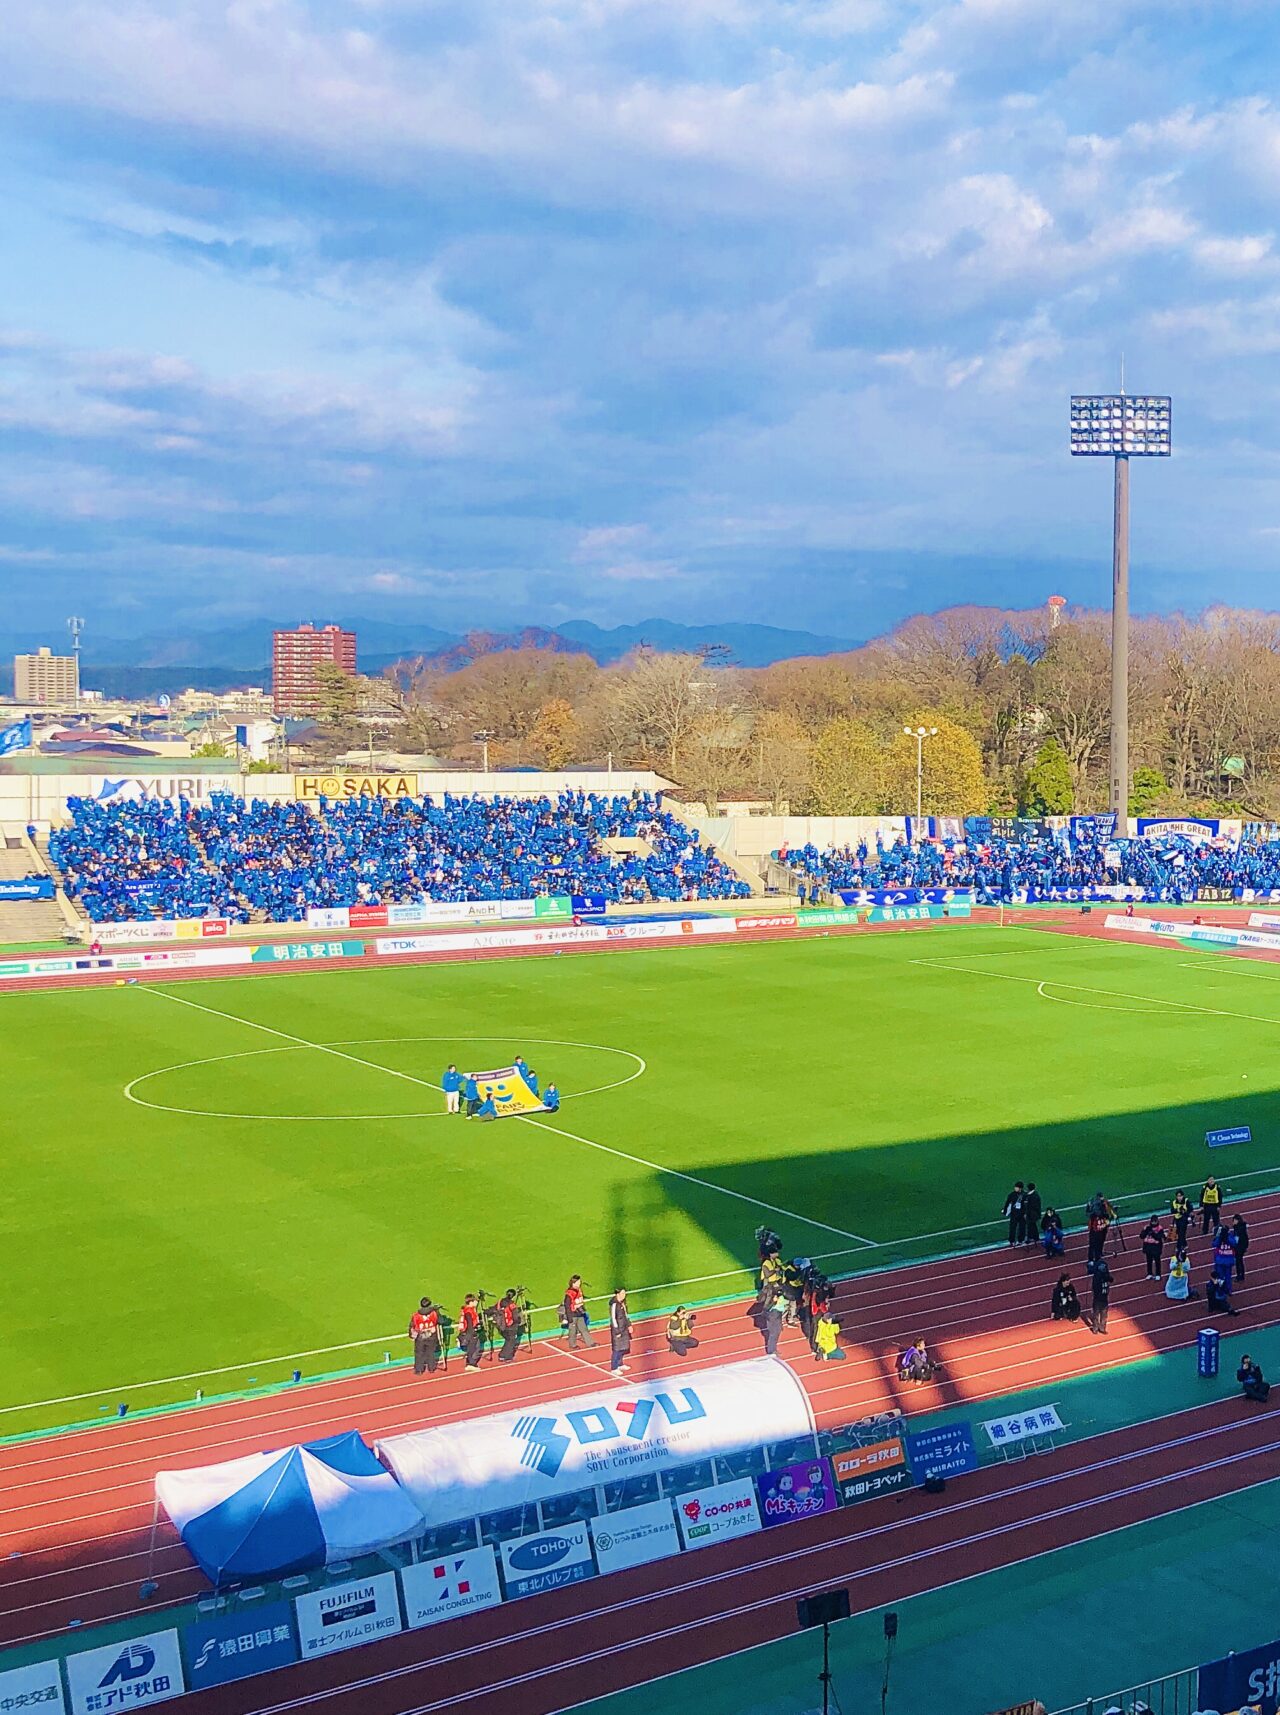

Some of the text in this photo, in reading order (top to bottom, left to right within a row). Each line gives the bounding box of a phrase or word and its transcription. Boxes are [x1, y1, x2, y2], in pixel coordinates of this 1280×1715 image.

[135, 779, 202, 798] YURI
[1187, 823, 1211, 836] GREAT
[882, 907, 930, 920] 明治安田
[96, 927, 150, 939] スポーツくじ
[606, 927, 625, 936] ADK
[629, 925, 666, 936] グループ
[273, 942, 344, 960] 明治安田
[390, 940, 417, 949] TDK
[511, 1387, 707, 1479] SOYU
[990, 1411, 1056, 1439] 細谷病院
[584, 1431, 691, 1462] The Amusement creator
[587, 1447, 669, 1473] SOYU Corporation
[838, 1447, 900, 1472] カローラ秋田
[932, 1458, 966, 1474] MIRAITO
[844, 1472, 906, 1499] 秋田トヨペット
[712, 1513, 756, 1532] コープあきた
[531, 1535, 584, 1557] TOHOKU
[320, 1586, 375, 1610] FUJIFILM
[417, 1591, 492, 1619] ZAISAN CONSULTING
[218, 1624, 291, 1659] 猿田興業
